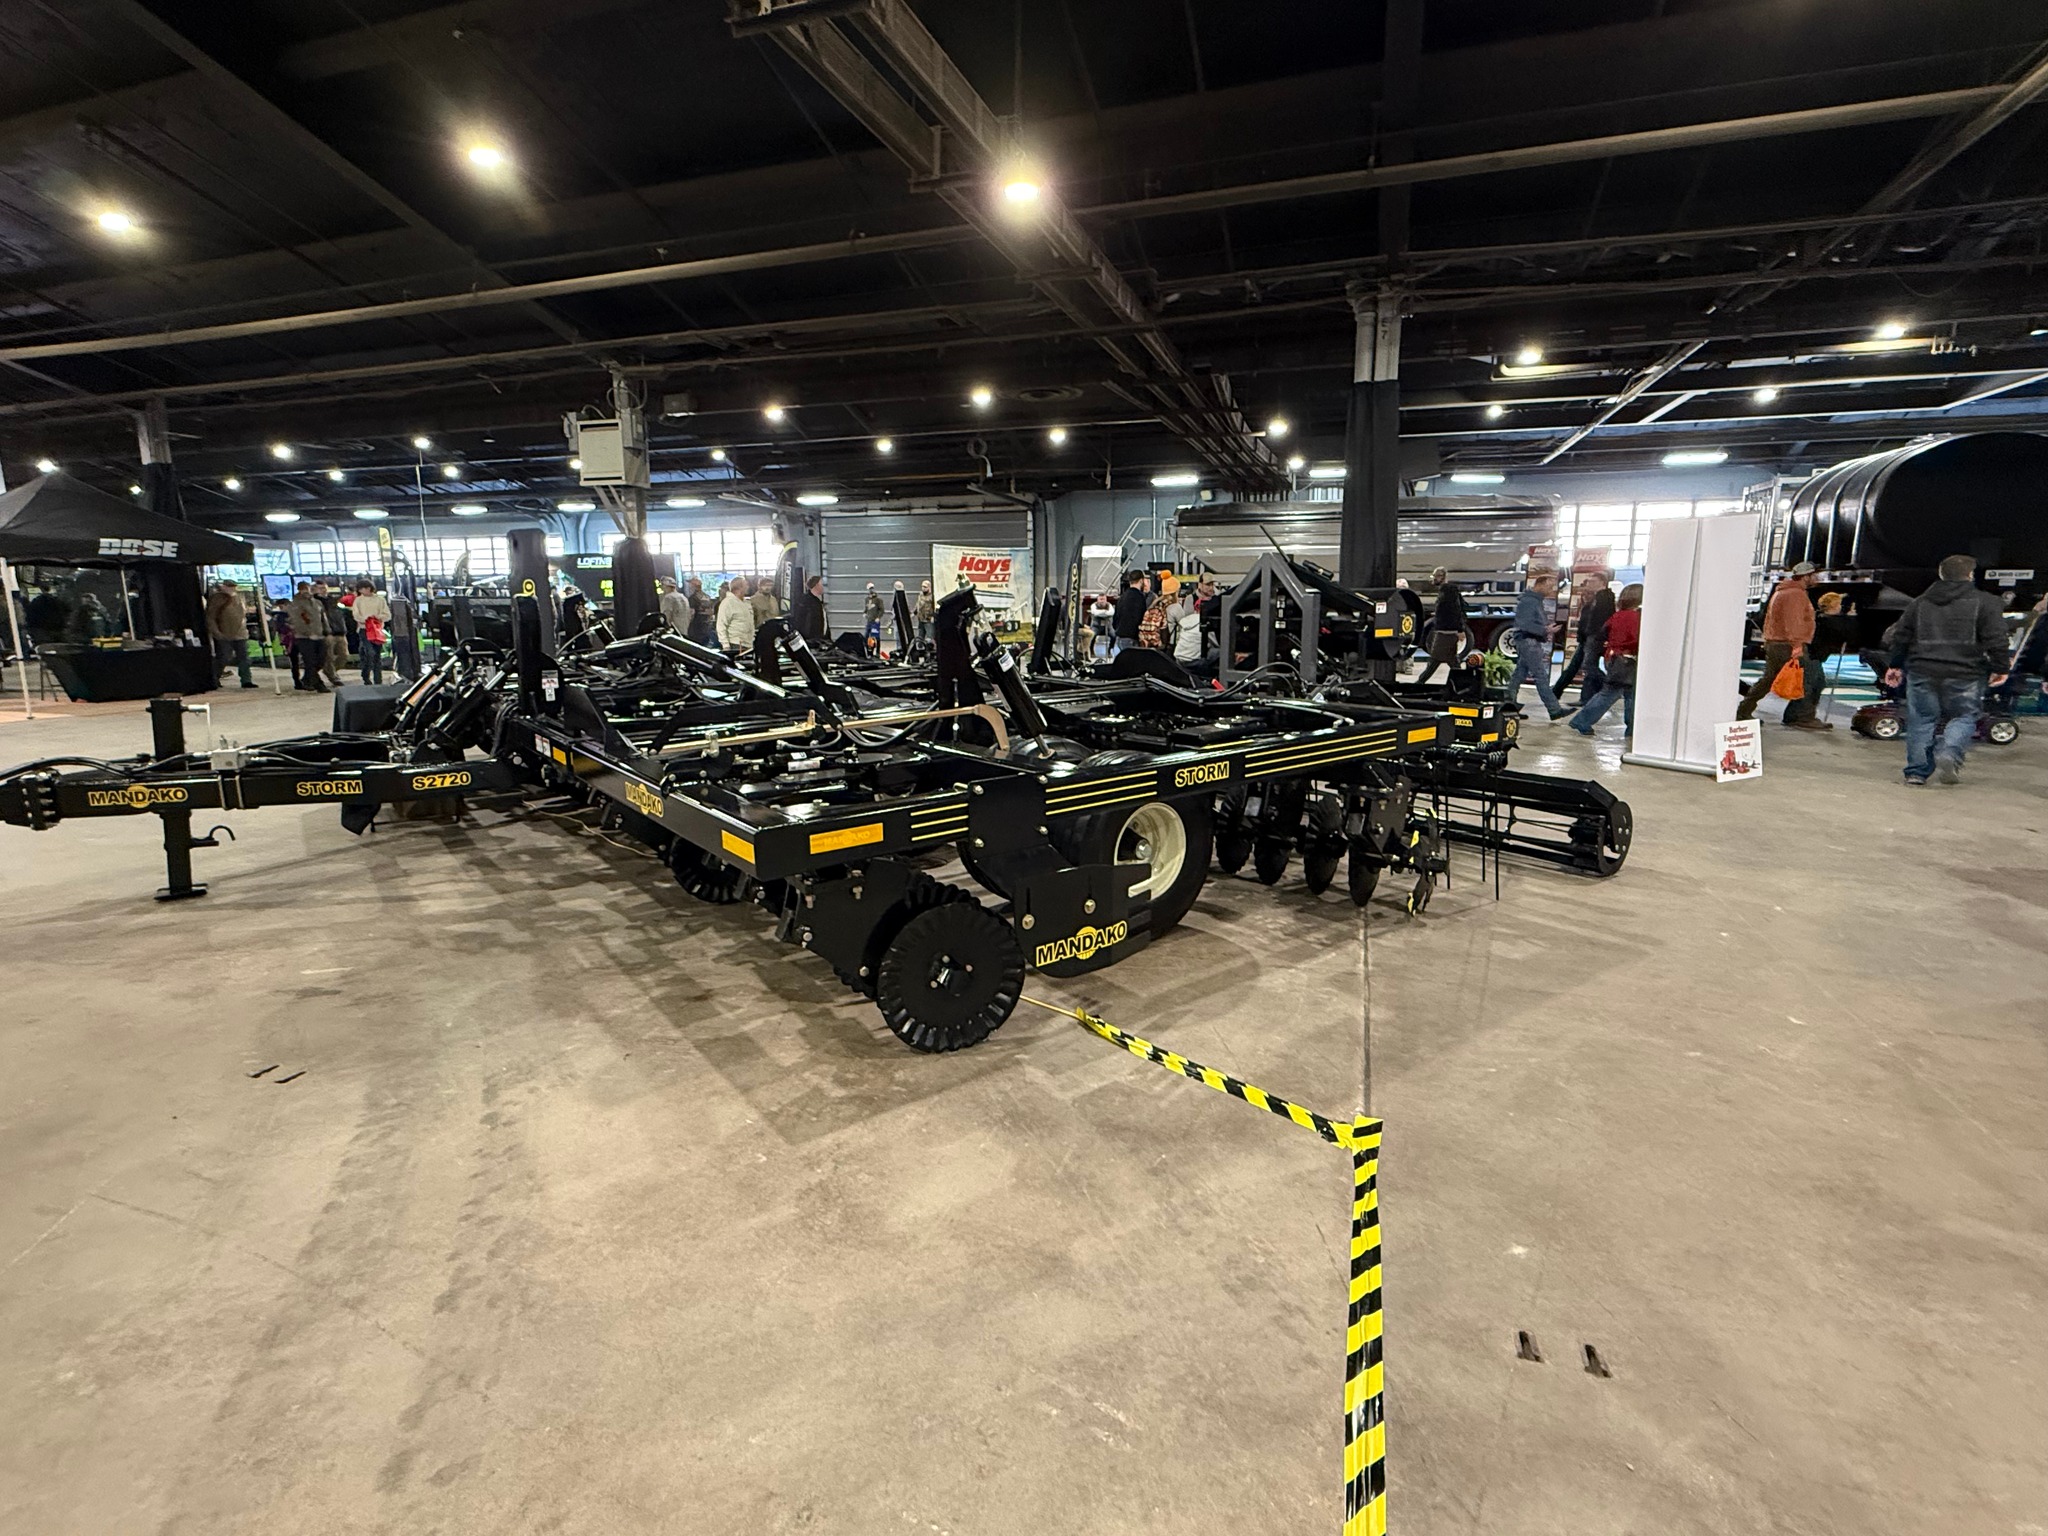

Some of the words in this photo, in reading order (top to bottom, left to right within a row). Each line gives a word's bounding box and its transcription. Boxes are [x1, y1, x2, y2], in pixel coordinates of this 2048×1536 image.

[958, 556, 1012, 574] Hays
[1729, 726, 1748, 734] Barber
[413, 771, 472, 790] S2720
[1175, 761, 1230, 788] STORM
[88, 786, 189, 807] MANDAKO
[297, 780, 363, 796] STORM
[625, 781, 664, 818] MANDAKO
[1036, 920, 1128, 967] MANDAKO
